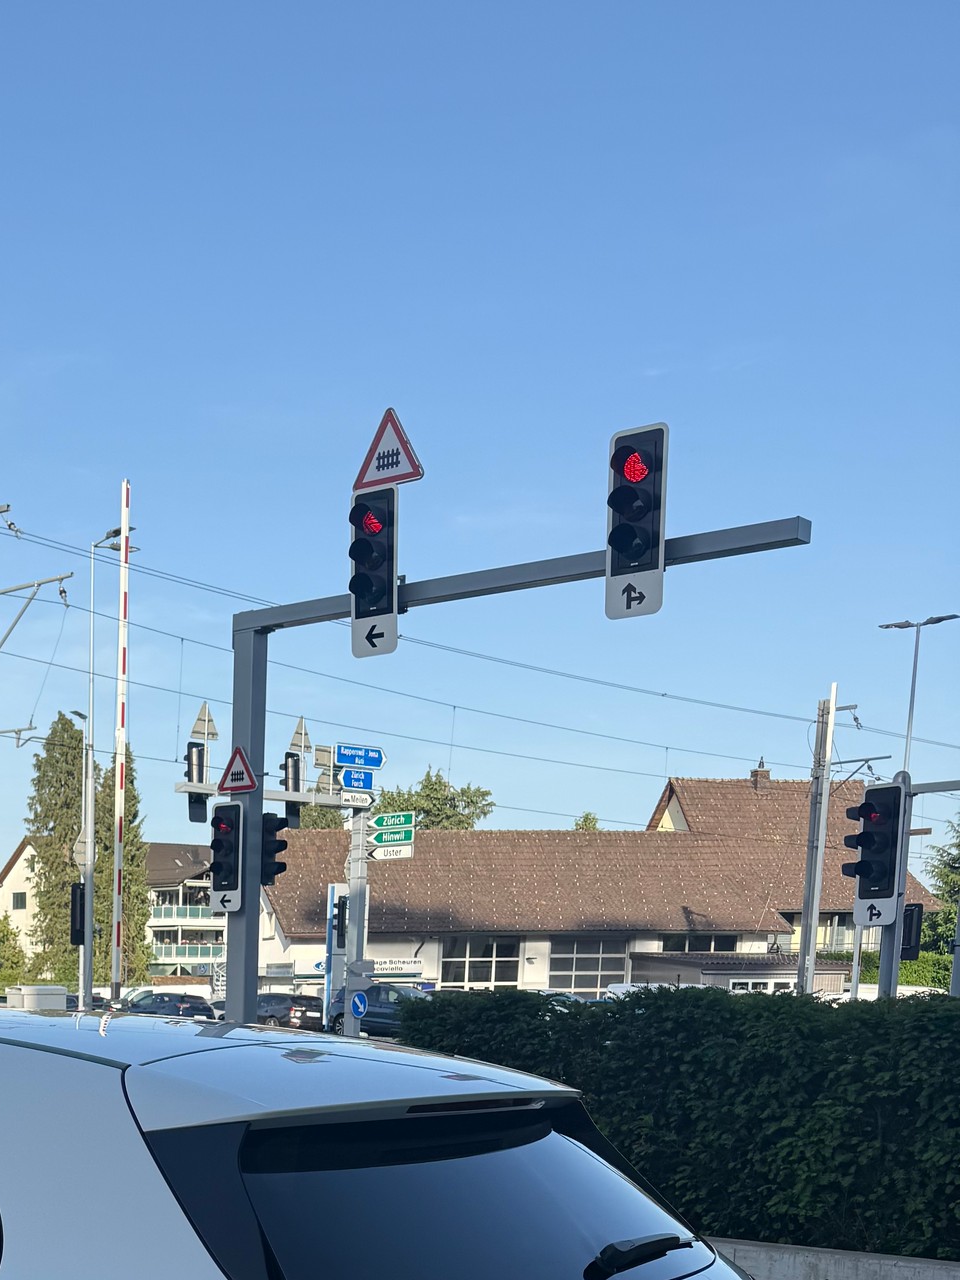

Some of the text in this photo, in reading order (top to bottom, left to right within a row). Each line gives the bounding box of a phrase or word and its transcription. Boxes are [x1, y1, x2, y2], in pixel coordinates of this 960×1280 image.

[351, 771, 364, 779] Zürich
[351, 795, 368, 804] Meilen
[382, 815, 405, 825] Zürich
[382, 831, 405, 842] Hinwil
[383, 849, 402, 857] Uster
